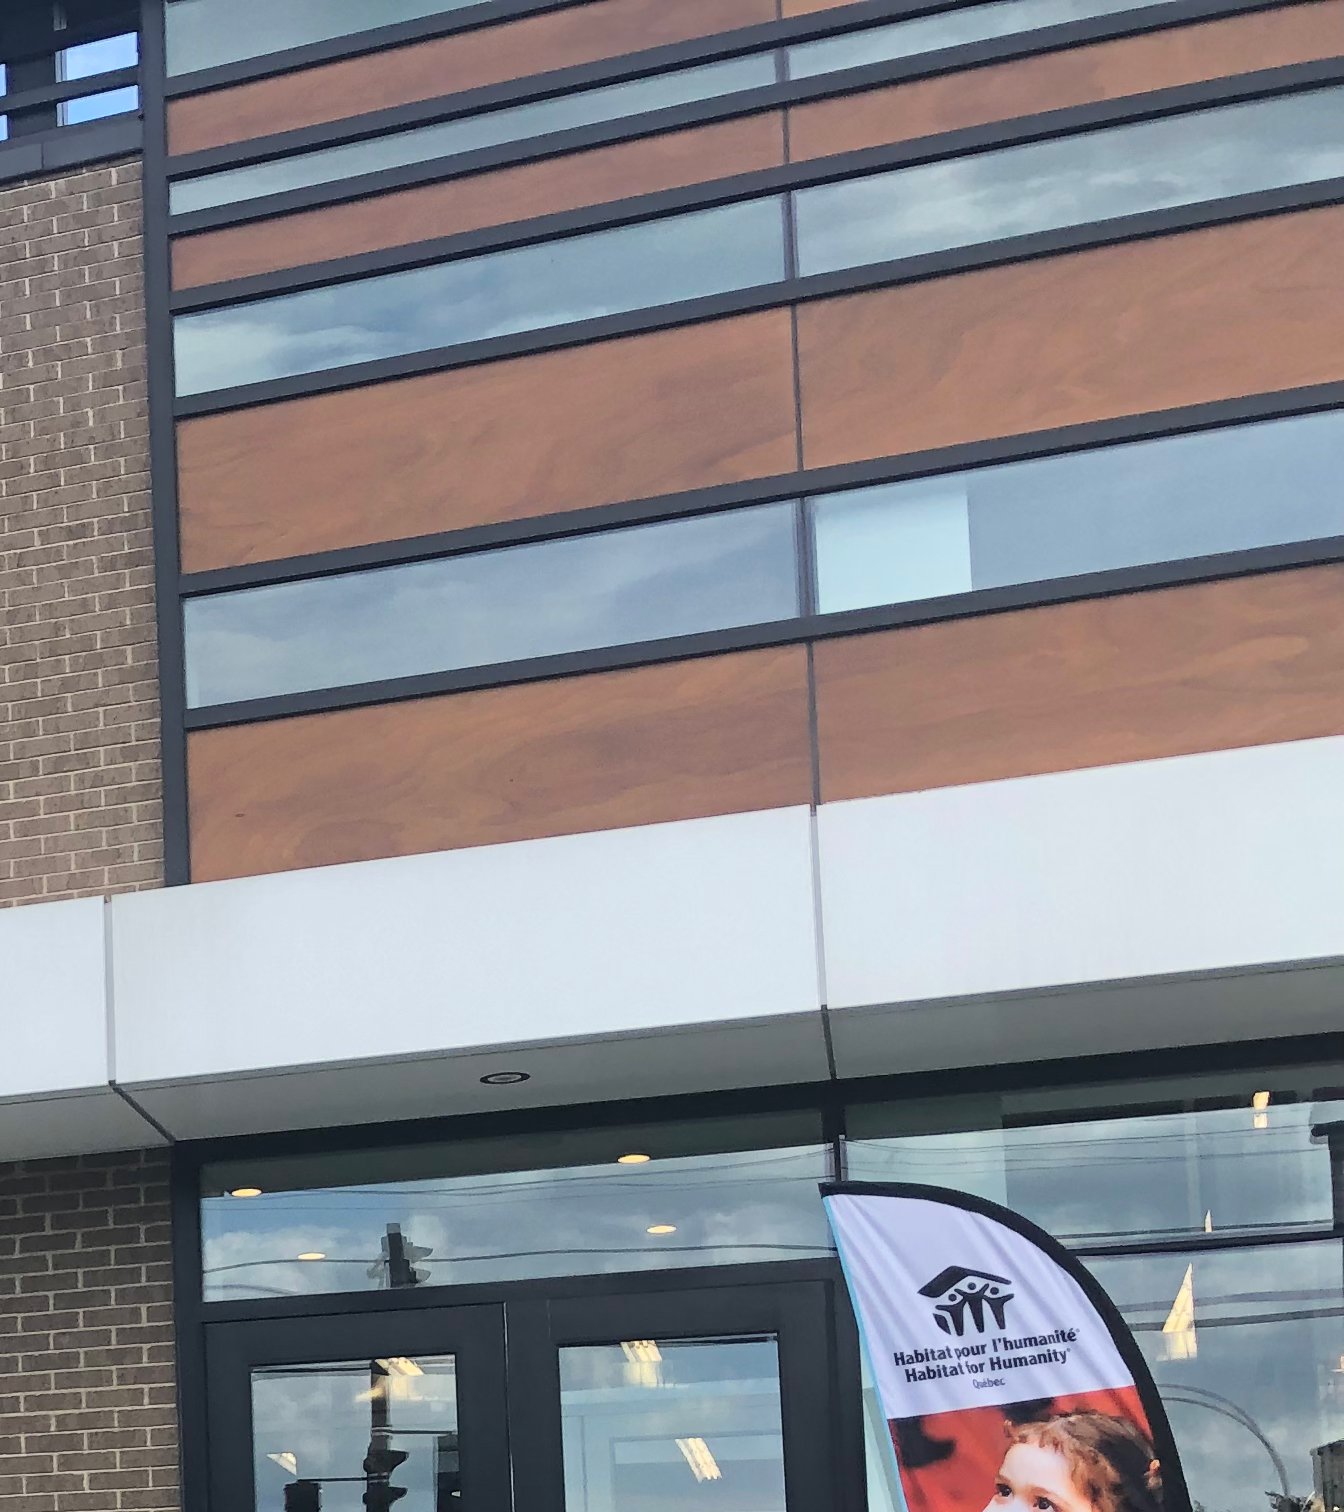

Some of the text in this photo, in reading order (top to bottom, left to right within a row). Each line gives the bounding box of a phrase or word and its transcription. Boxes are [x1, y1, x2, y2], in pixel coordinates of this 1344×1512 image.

[893, 1346, 952, 1367] Habitat
[955, 1343, 987, 1361] pour
[905, 1364, 965, 1383] Habitat
[965, 1360, 985, 1375] for
[972, 1377, 1006, 1390] Québec
